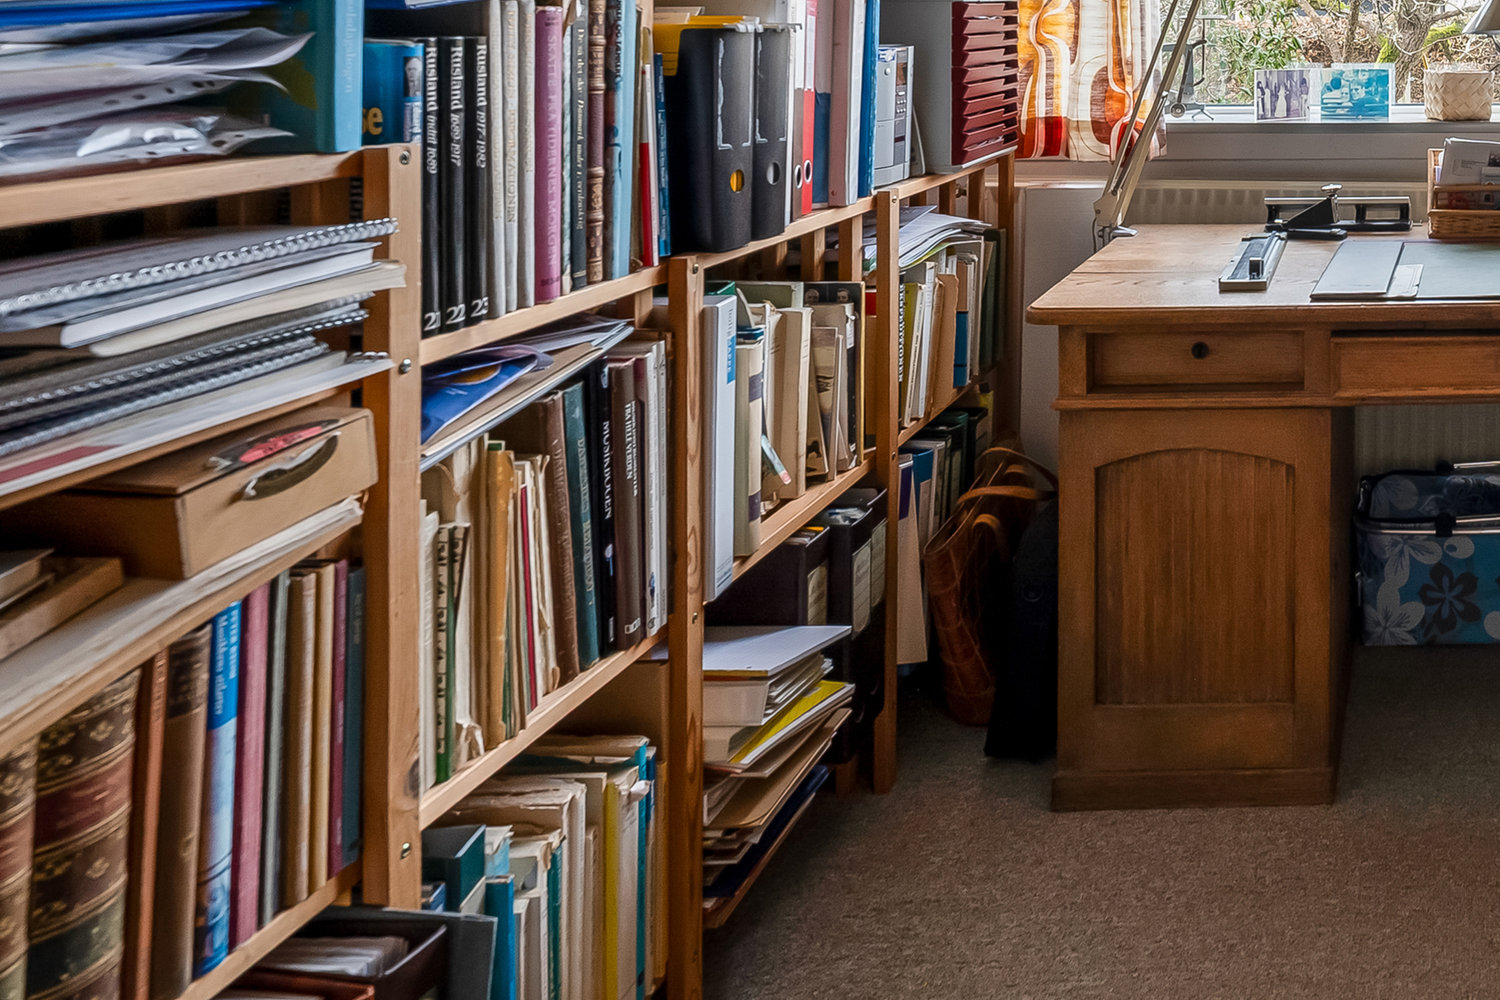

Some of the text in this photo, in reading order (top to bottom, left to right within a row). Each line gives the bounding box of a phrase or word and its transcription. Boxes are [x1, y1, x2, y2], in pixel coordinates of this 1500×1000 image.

[425, 46, 439, 175] Rusland indtil 1689
[449, 46, 464, 168] Rusland 1689-1917
[475, 44, 488, 169] Rusland 1917-1982
[423, 310, 442, 332] 21
[445, 303, 467, 326] 22
[602, 419, 613, 521] MUSIKBOGEN
